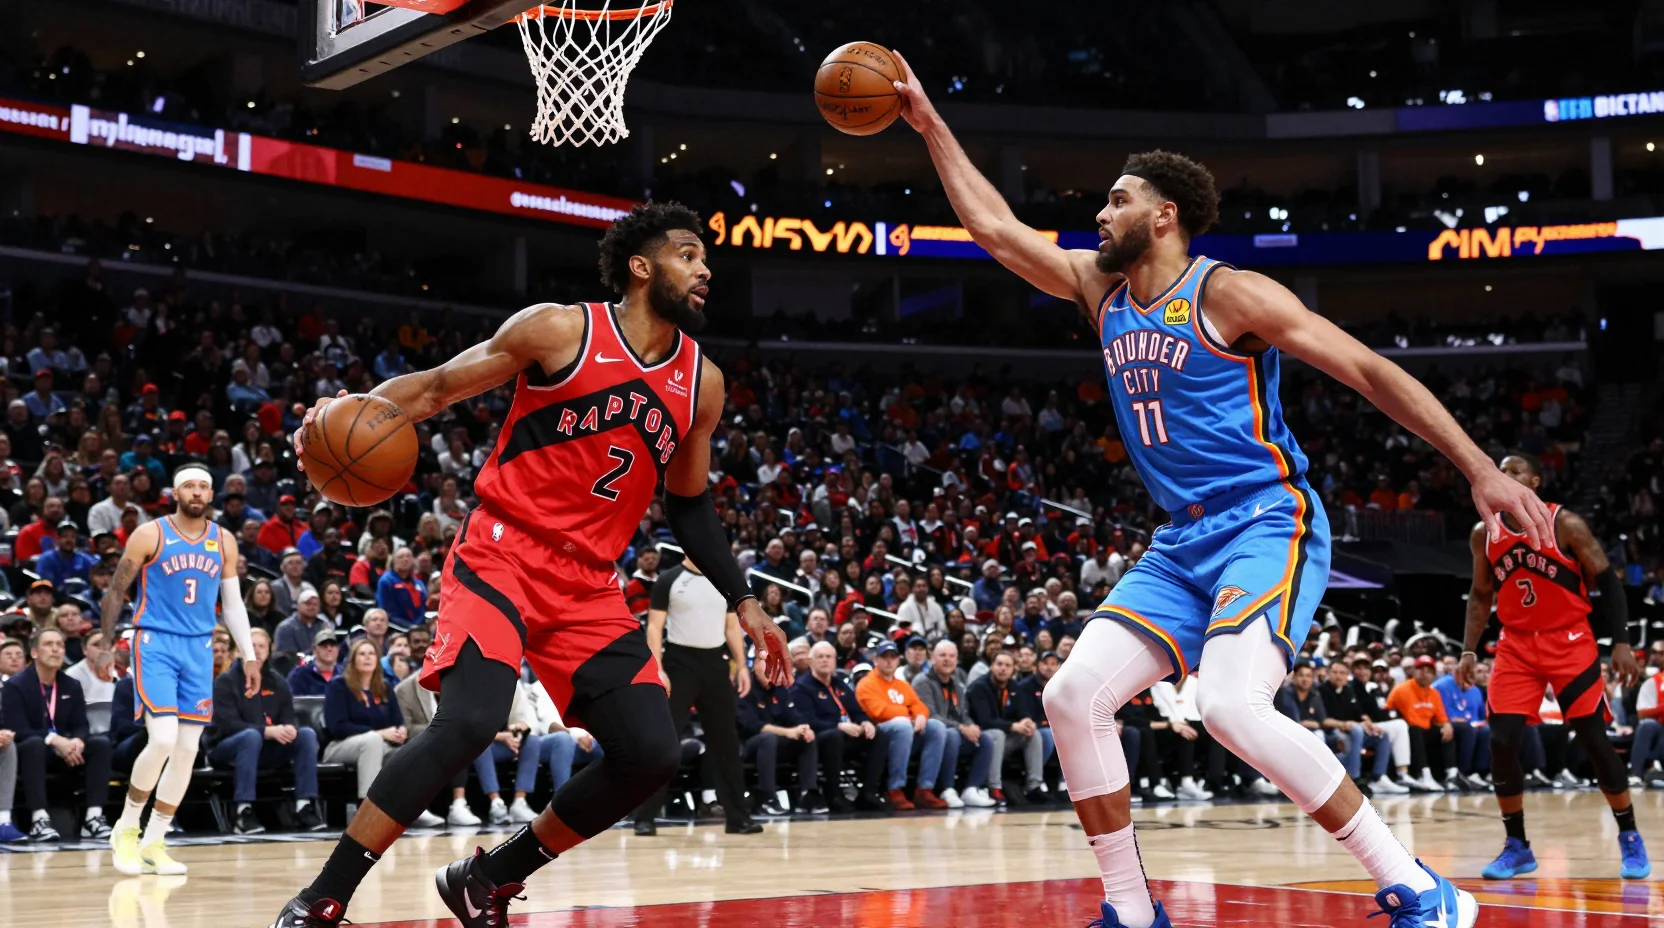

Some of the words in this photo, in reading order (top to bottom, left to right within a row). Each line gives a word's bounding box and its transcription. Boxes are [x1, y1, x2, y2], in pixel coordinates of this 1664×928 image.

[1122, 367, 1160, 395] CITY
[557, 391, 676, 464] RAPTORS
[1132, 399, 1169, 447] 11
[590, 445, 636, 502] 2
[184, 578, 198, 605] 3
